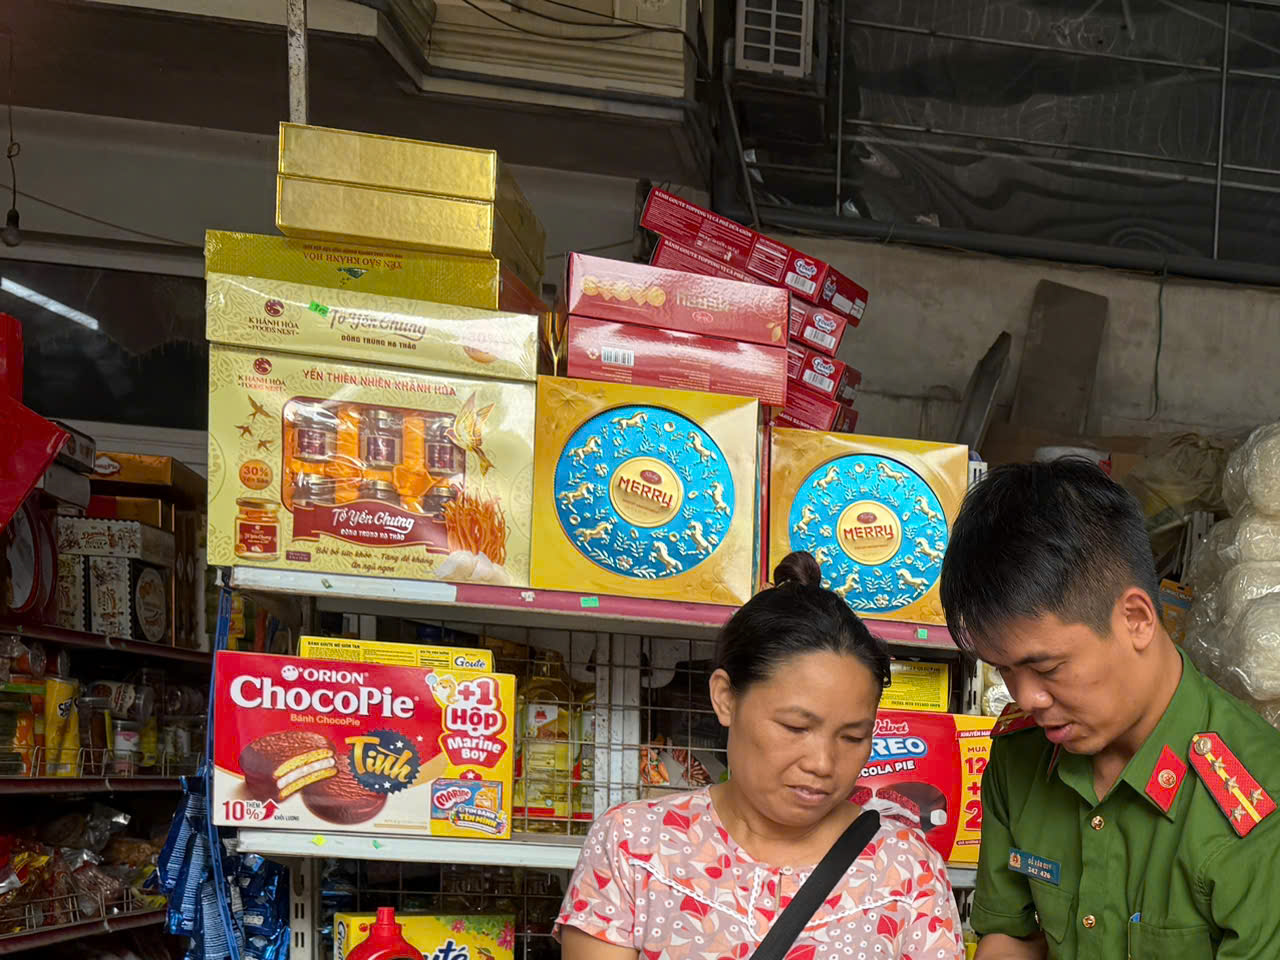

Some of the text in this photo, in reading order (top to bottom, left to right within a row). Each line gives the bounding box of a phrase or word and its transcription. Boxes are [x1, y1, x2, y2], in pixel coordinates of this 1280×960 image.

[243, 466, 269, 477] 30%
[303, 669, 364, 685] ORION
[229, 674, 415, 719] ChocoPie
[457, 677, 494, 705] +1
[290, 712, 361, 727] Bánh ChocoPie
[450, 708, 499, 736] Hộp
[447, 736, 502, 754] Marine
[872, 738, 926, 755] REO
[460, 748, 488, 763] Boy
[895, 760, 915, 772] PIE
[964, 757, 987, 775] 12
[223, 801, 245, 821] 10
